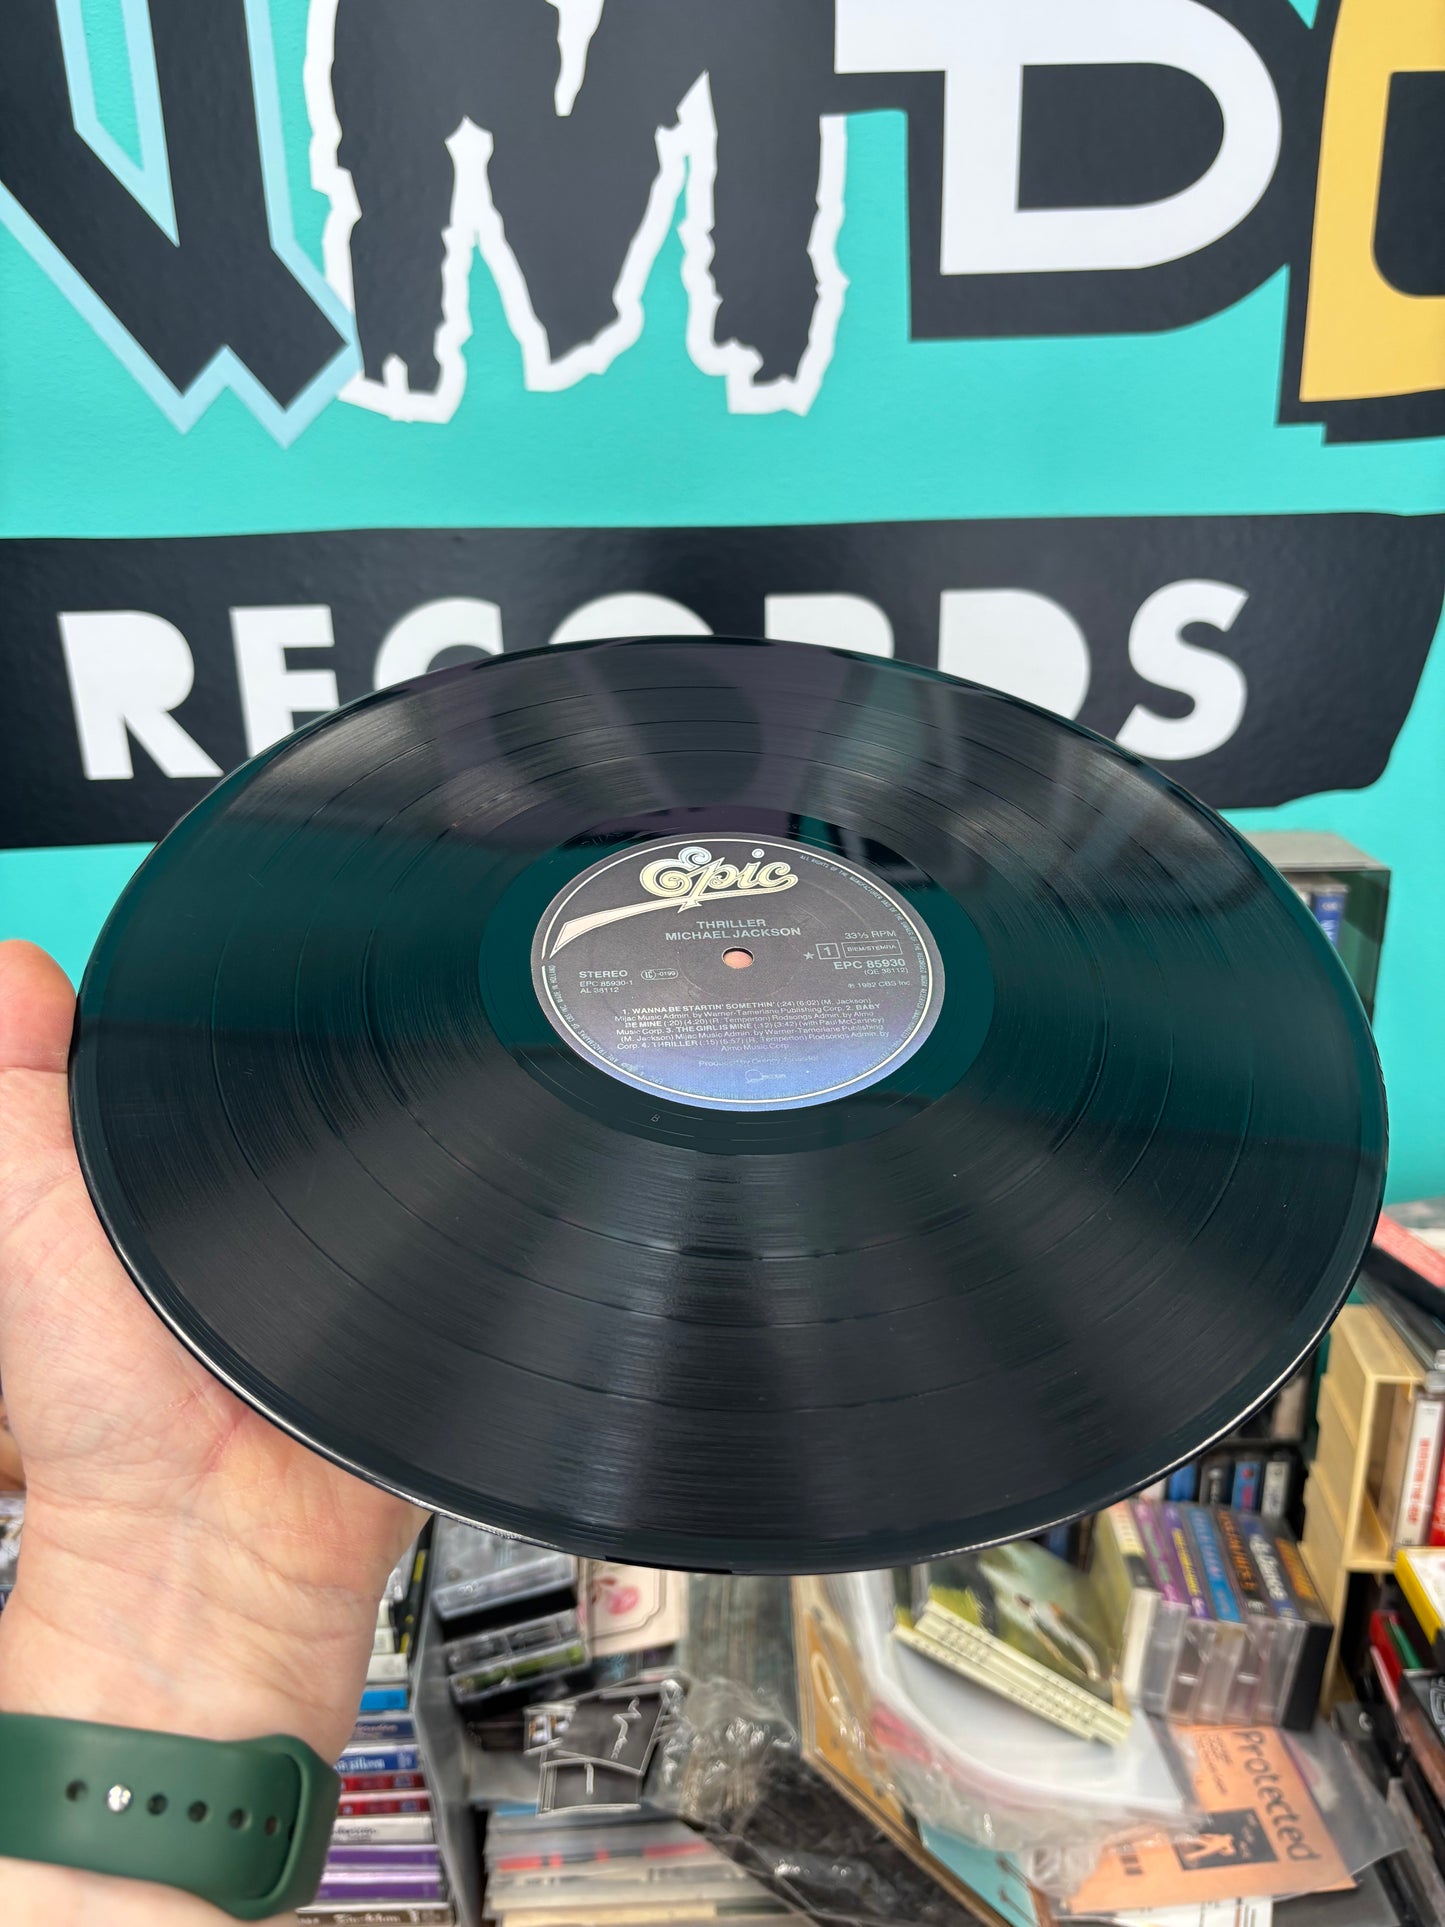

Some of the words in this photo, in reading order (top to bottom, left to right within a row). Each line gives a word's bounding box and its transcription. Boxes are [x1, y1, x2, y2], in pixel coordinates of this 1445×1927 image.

[58, 579, 1249, 780] REDS
[696, 919, 766, 929] THRILLER
[665, 930, 731, 941] MICHAEL
[732, 927, 801, 938] JACKSON
[871, 930, 897, 938] RPM
[833, 961, 863, 970] EPC
[866, 959, 906, 969] 85930
[579, 970, 628, 978] STEREO
[632, 1007, 667, 1015] WANNA
[683, 1004, 723, 1012] STARTIN'
[725, 1002, 775, 1010] SOMETHIN'
[704, 1009, 780, 1017] Warner-Tamerlane
[781, 1006, 822, 1014] Publishing
[723, 1015, 771, 1024] Temperton)
[772, 1013, 812, 1021] Rodsongs
[636, 1034, 674, 1042] Jackson)
[842, 1024, 884, 1032] Publishing
[642, 1028, 665, 1036] Corp.
[1233, 1729, 1322, 1861] Protected
